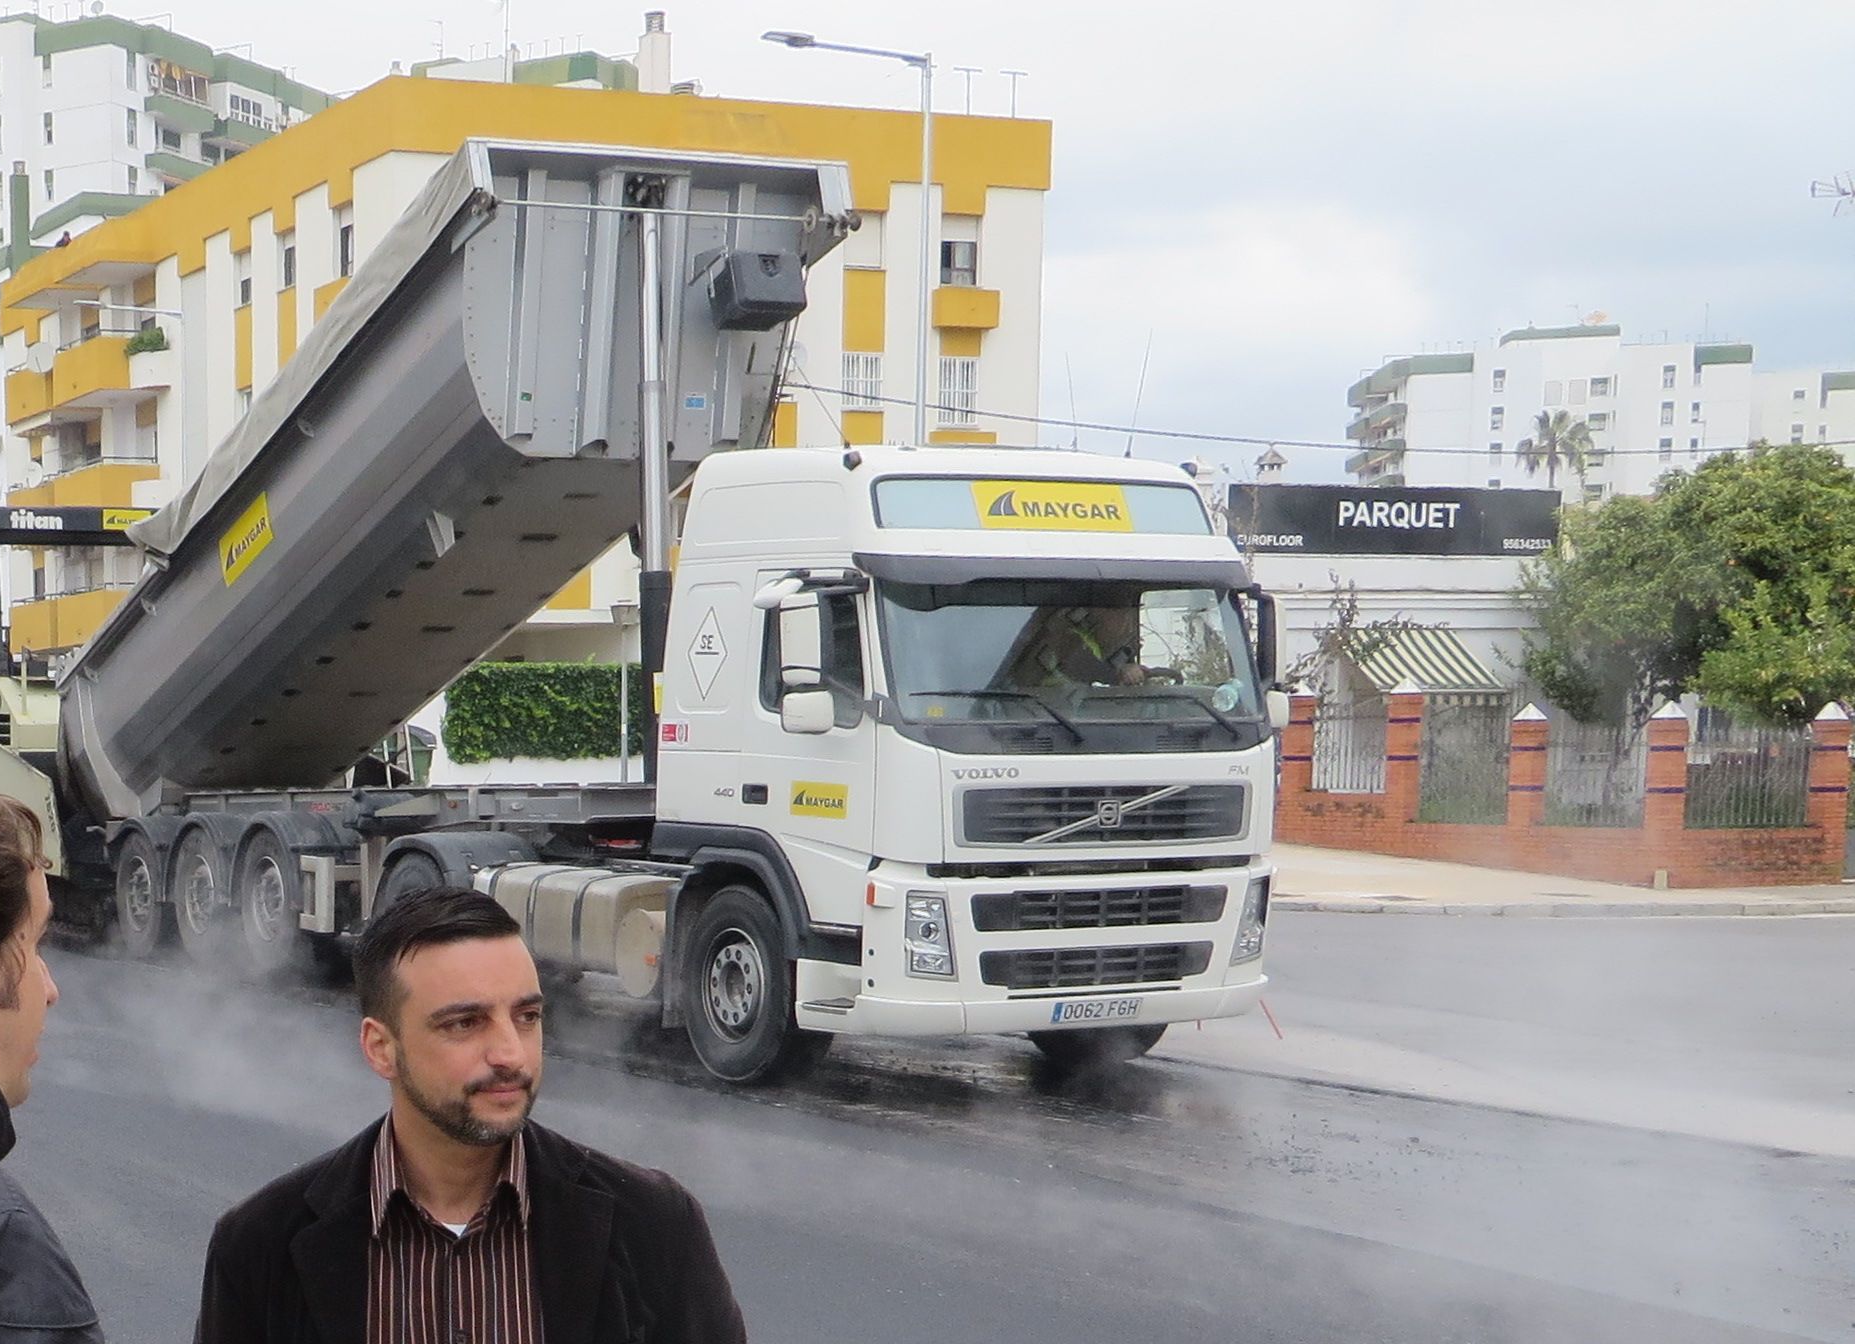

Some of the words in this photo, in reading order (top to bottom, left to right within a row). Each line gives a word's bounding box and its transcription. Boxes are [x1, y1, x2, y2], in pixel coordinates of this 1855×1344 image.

[1021, 501, 1121, 520] MAYGAR
[1338, 501, 1460, 529] PARQUET
[10, 509, 63, 530] titan
[235, 516, 267, 558] MAYGAR
[1236, 534, 1304, 547] EUROFLOOR
[950, 767, 1020, 780] VOLVO
[1228, 765, 1250, 776] FM
[713, 787, 735, 798] 440
[805, 796, 844, 809] MAYGAR
[1064, 1003, 1104, 1020] 0062
[1107, 1000, 1139, 1017] FGH
